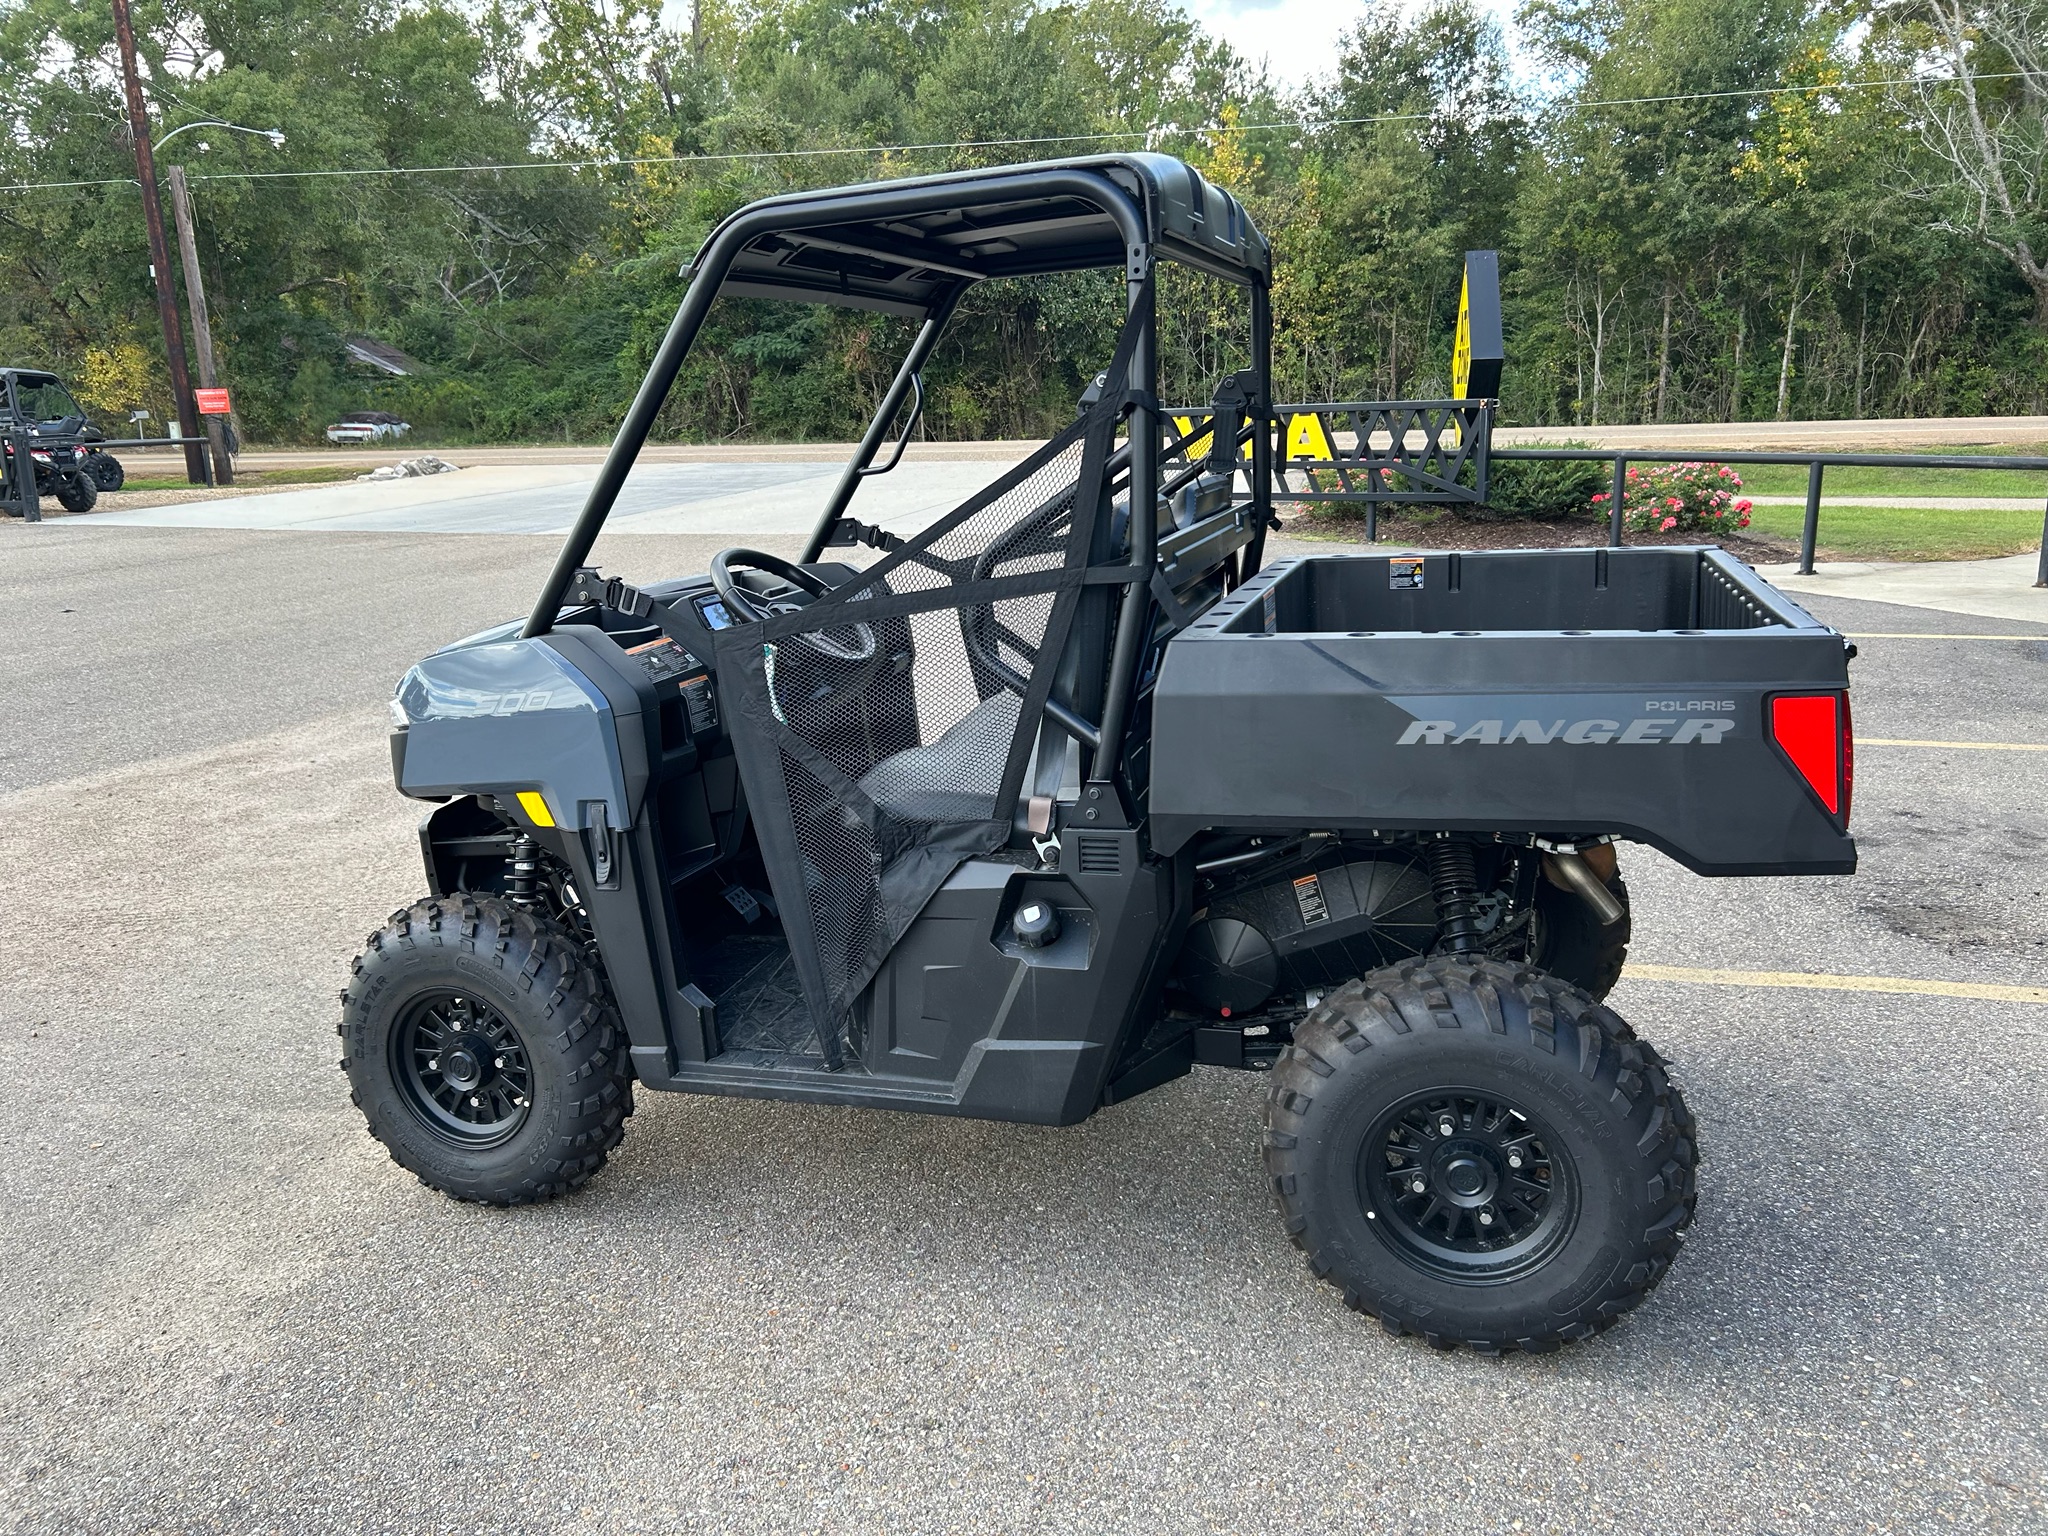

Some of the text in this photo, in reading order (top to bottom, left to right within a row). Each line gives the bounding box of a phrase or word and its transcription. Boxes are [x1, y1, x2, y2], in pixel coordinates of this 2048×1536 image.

[473, 690, 554, 715] 500
[1645, 700, 1736, 711] POLARIS
[1396, 718, 1735, 744] RANGER
[354, 974, 389, 1060] CARLSTAR
[1495, 1048, 1613, 1139] CARLSTAR
